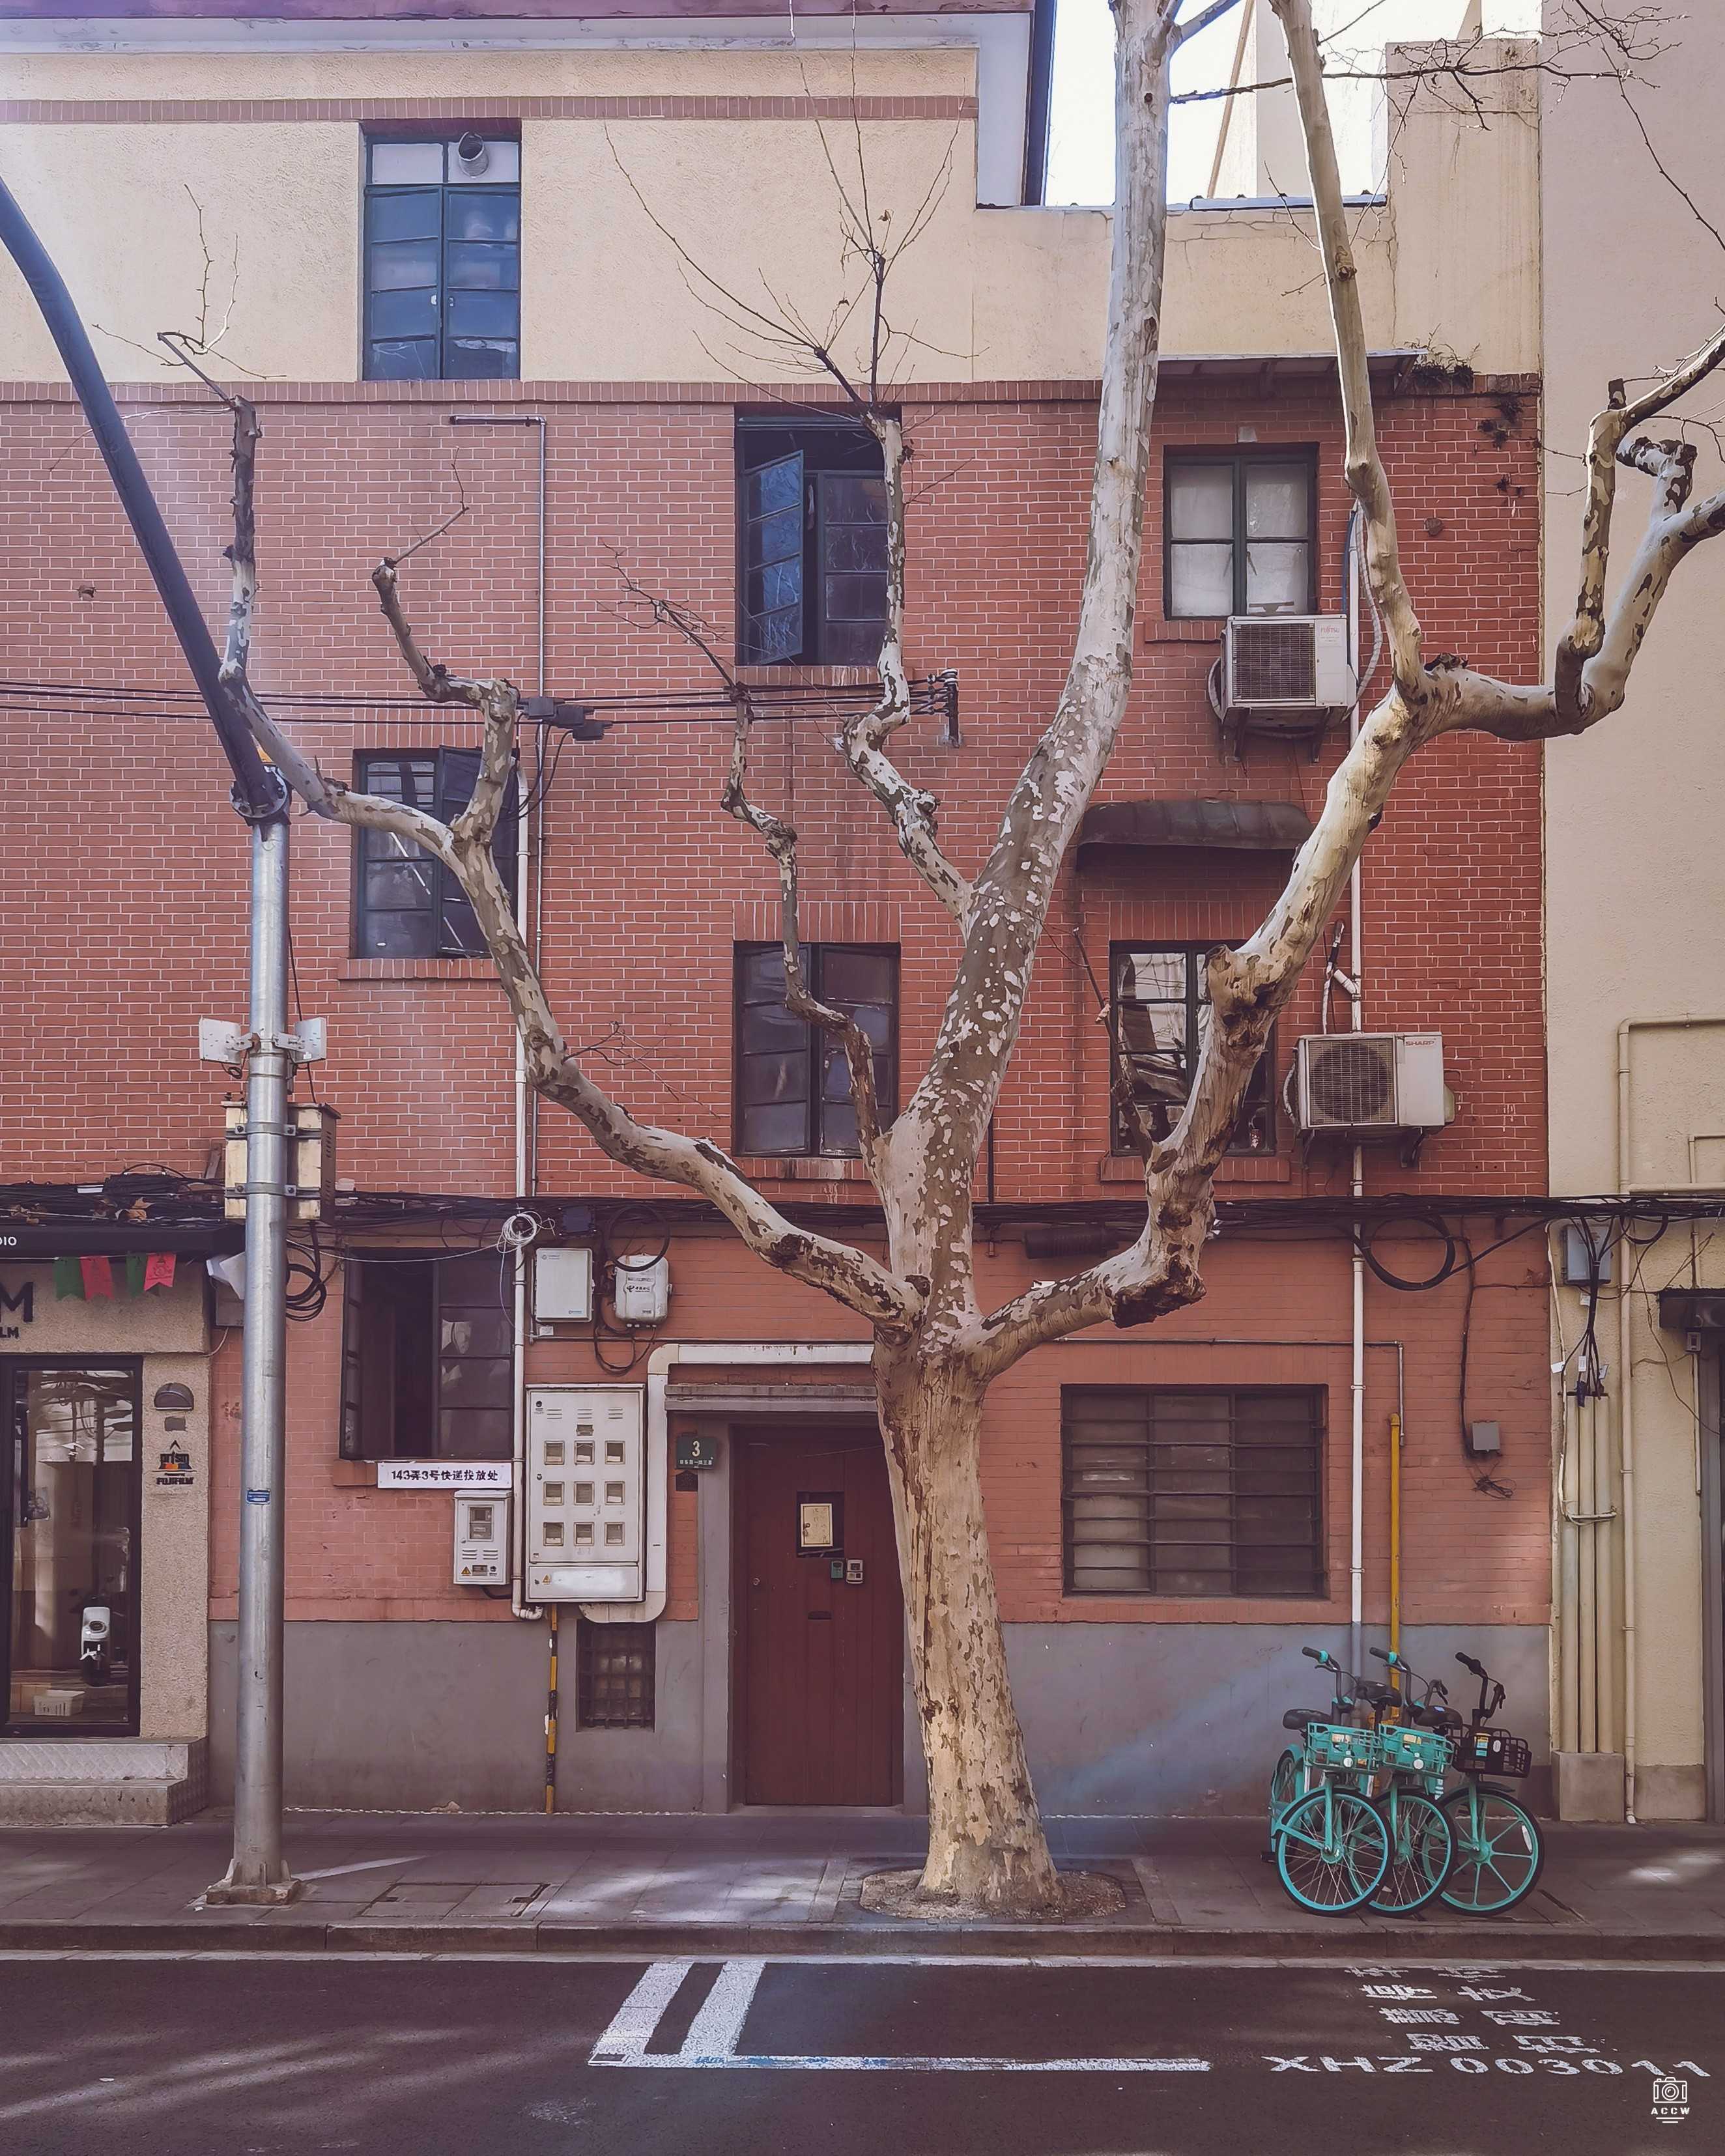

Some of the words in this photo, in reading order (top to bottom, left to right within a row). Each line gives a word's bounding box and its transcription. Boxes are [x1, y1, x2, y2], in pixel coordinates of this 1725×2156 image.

[692, 1440, 700, 1457] 3
[392, 1469, 498, 1481] 143弄3号快递投放处
[1262, 2056, 1434, 2073] XHZ
[1450, 2057, 1711, 2077] 003011
